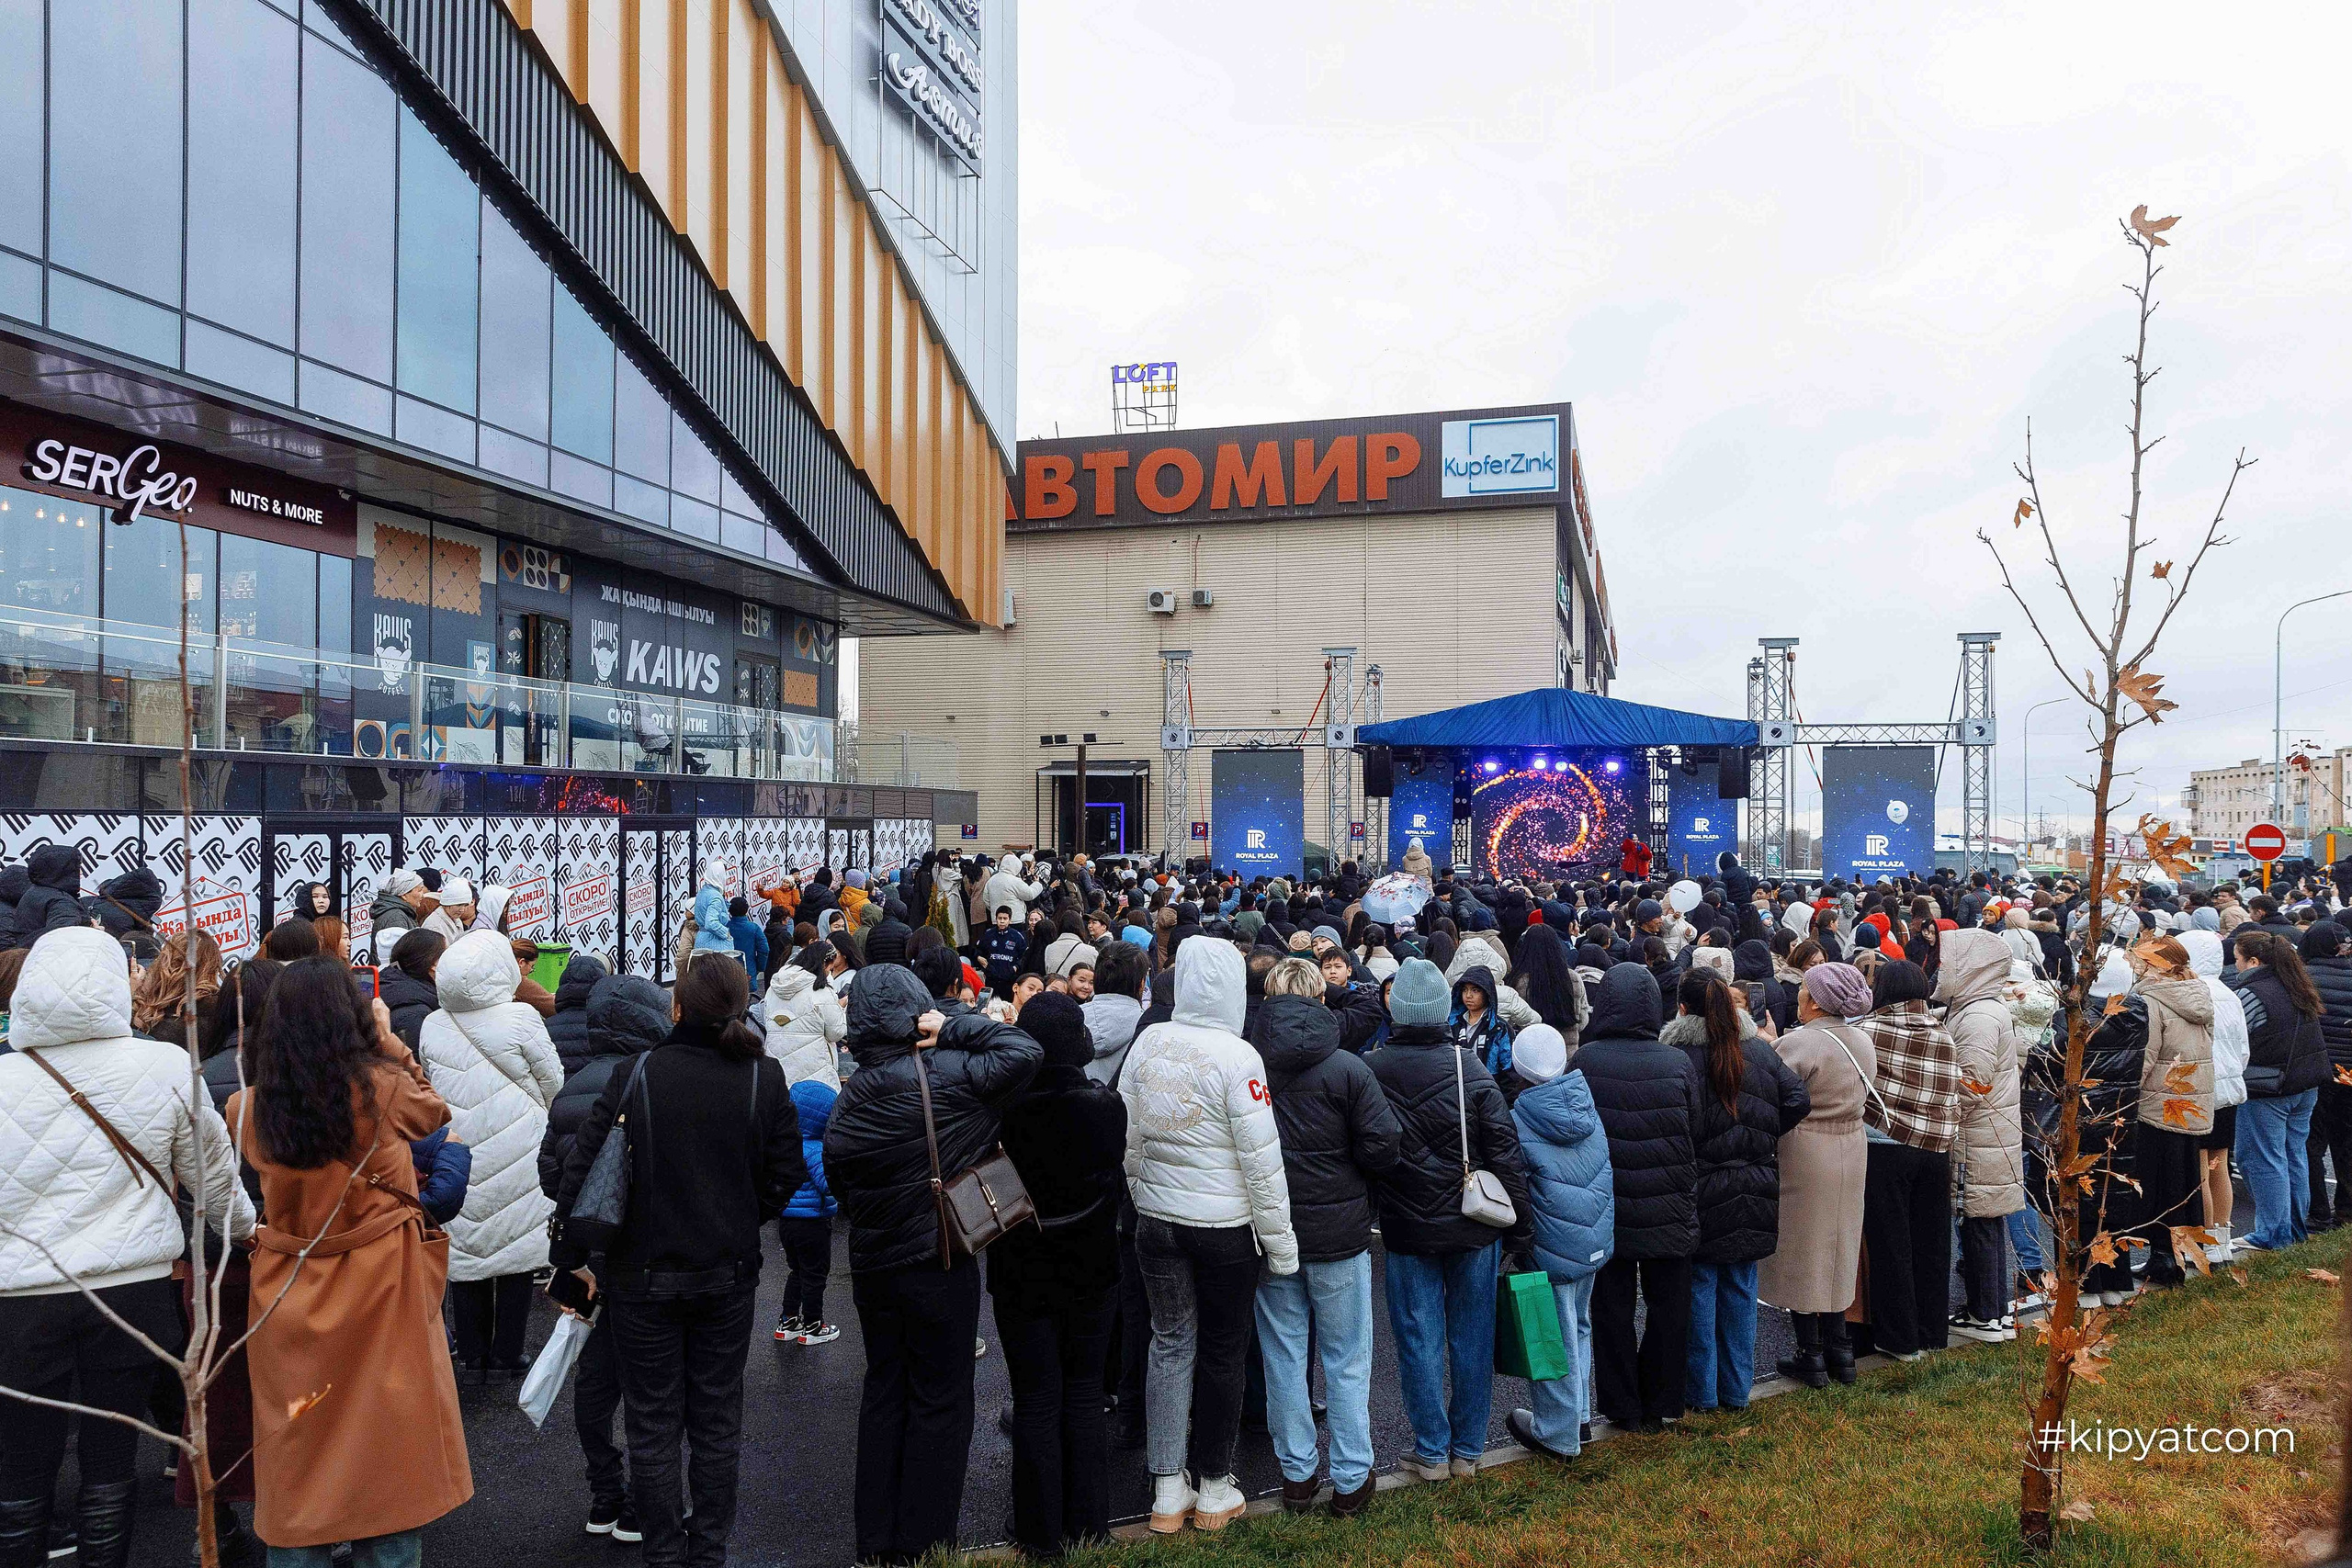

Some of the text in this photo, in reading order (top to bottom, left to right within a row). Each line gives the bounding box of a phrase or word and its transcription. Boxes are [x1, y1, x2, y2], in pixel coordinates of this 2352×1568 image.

[894, 0, 942, 45] ADY
[943, 31, 982, 92] BOSS
[1114, 362, 1177, 383] LOFT
[1143, 384, 1176, 393] PARK
[1005, 433, 1421, 520] ВТОМИР
[231, 489, 323, 525] NUTS & MORE
[626, 639, 721, 694] KAWS
[378, 682, 405, 696] COFFEE
[607, 707, 633, 726] СКО
[569, 882, 606, 907] СКОРО
[629, 886, 651, 901] СКОРО
[570, 897, 608, 919] ОТКРЫТИЕ!
[156, 908, 242, 938] Жаында
